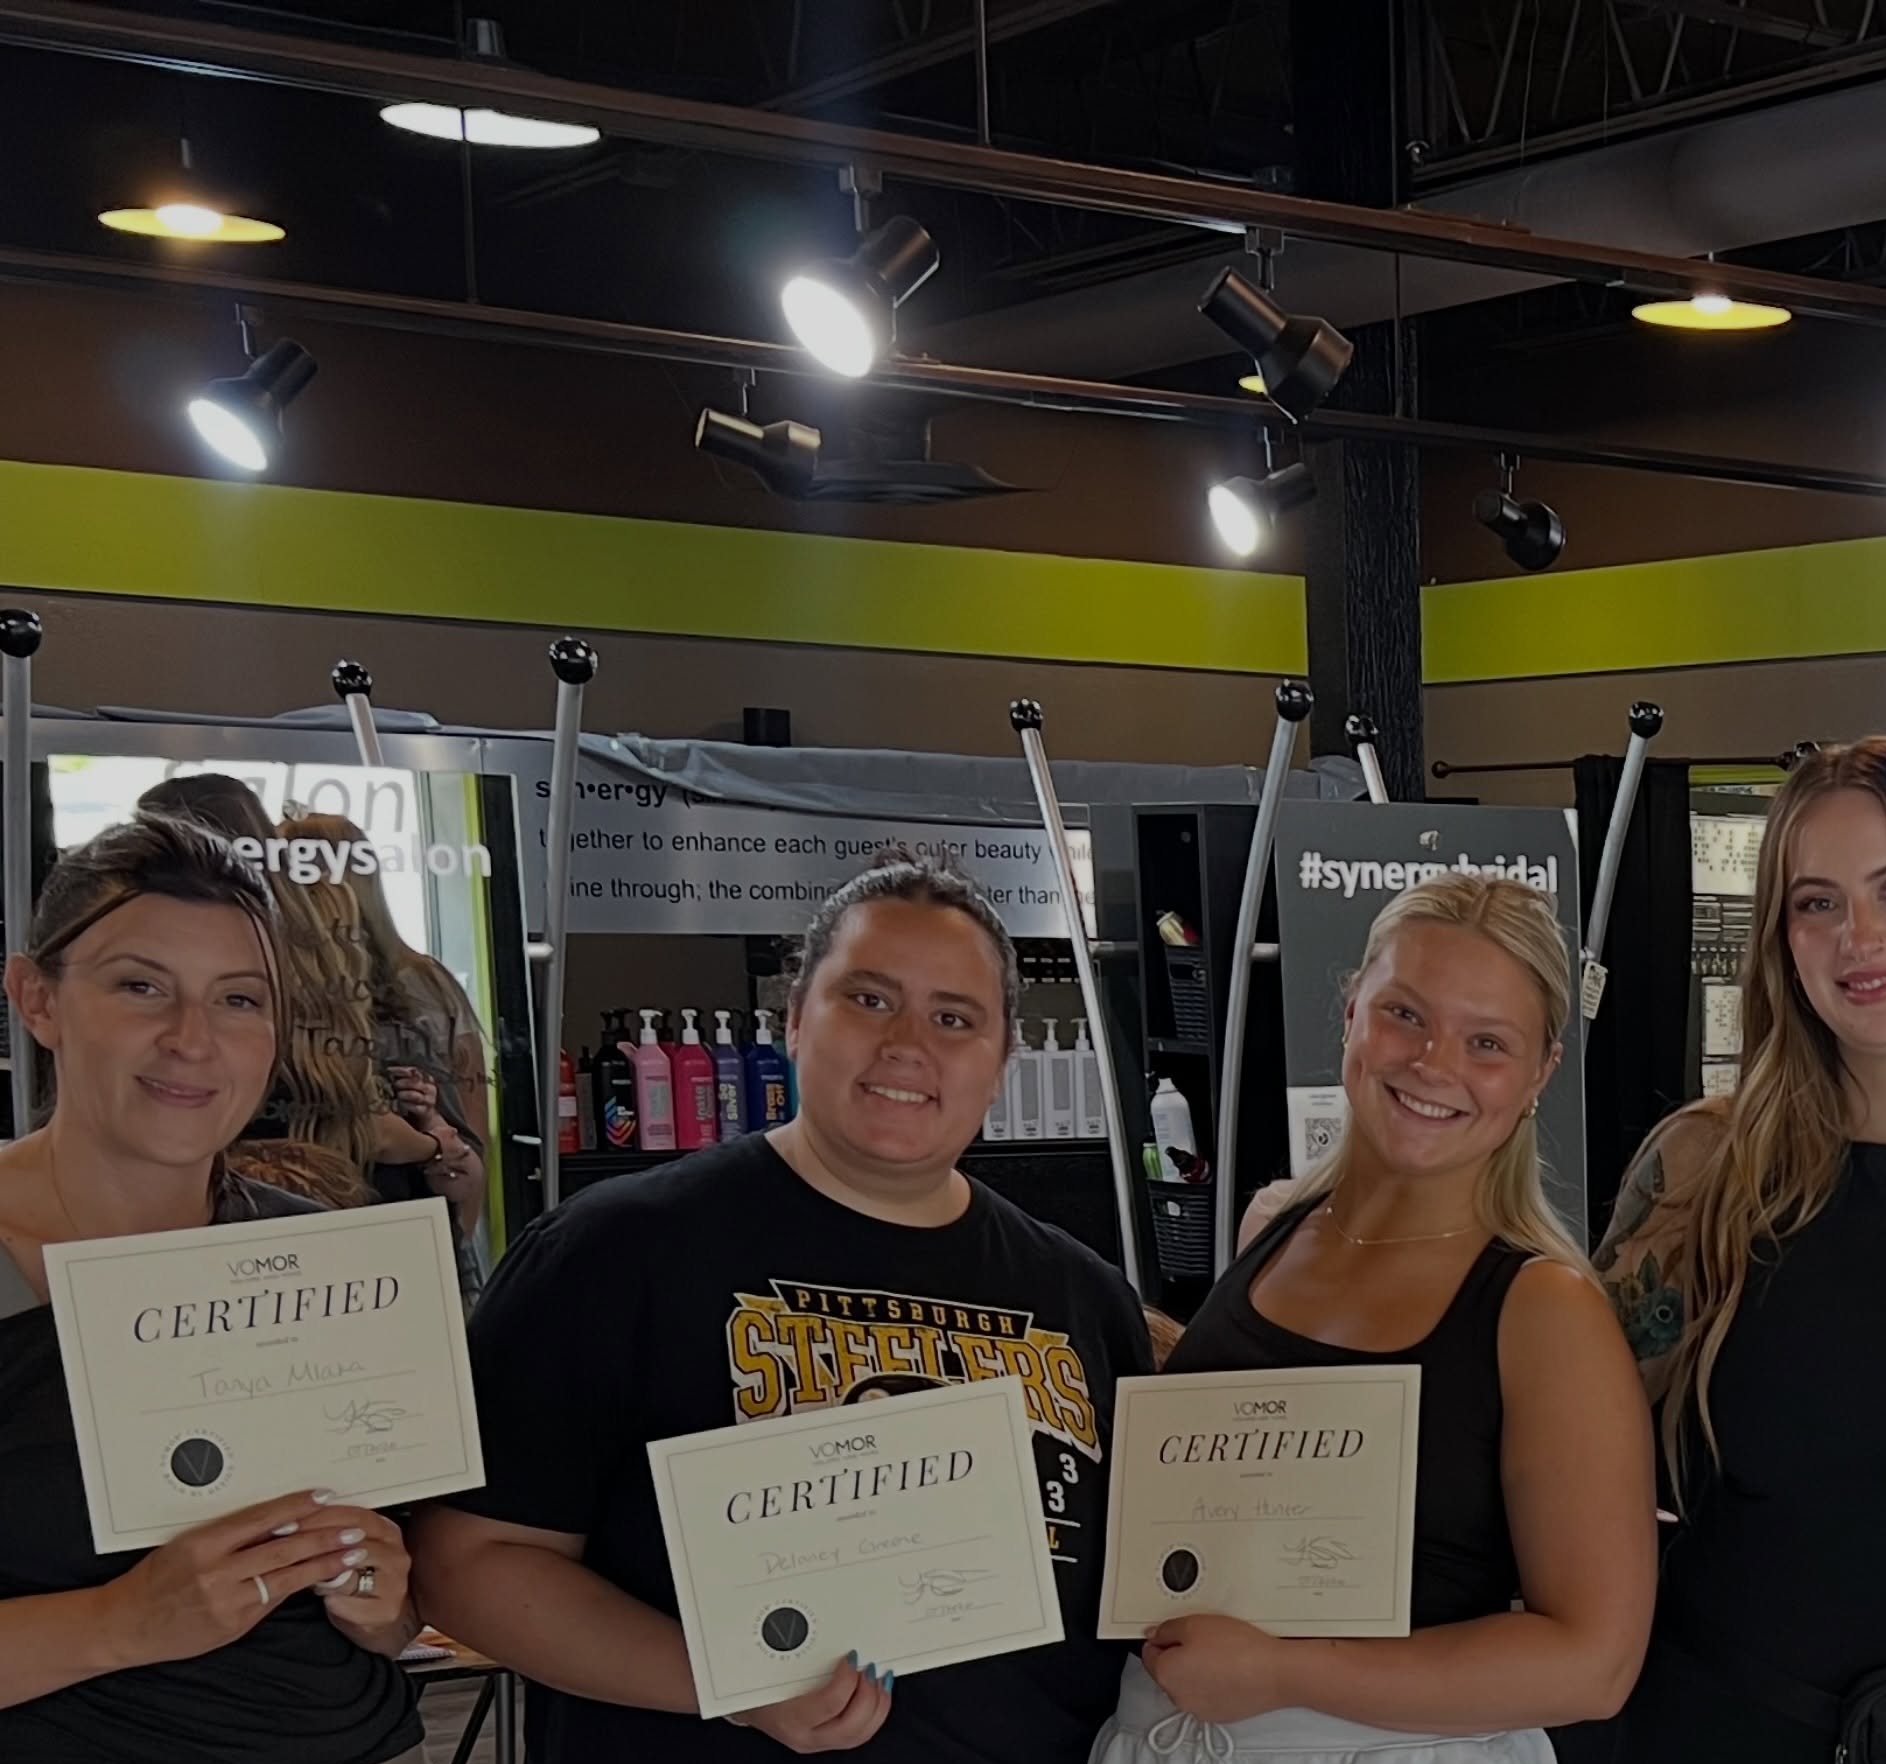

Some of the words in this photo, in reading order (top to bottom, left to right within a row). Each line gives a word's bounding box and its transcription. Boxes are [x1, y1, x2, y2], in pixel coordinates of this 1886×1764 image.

[231, 834, 493, 885] ergysalon
[539, 829, 634, 852] tether
[643, 831, 664, 850] to
[671, 832, 766, 853] enhance
[774, 835, 826, 854] each
[974, 839, 1041, 865] beauty
[709, 880, 742, 900] the
[749, 880, 838, 901] combine
[1019, 886, 1060, 905] than
[1299, 850, 1558, 899] #synerbidal
[226, 1253, 302, 1279] VOMOR
[132, 1275, 400, 1344] CERTIFIED
[795, 1288, 1017, 1336] PITTSBURGH
[729, 1309, 1098, 1451] STEELERS
[1232, 1400, 1288, 1417] VOMOR
[808, 1434, 877, 1459] VOMOR
[1159, 1428, 1364, 1465] CERTIFIED
[726, 1449, 974, 1525] CERTIFIED
